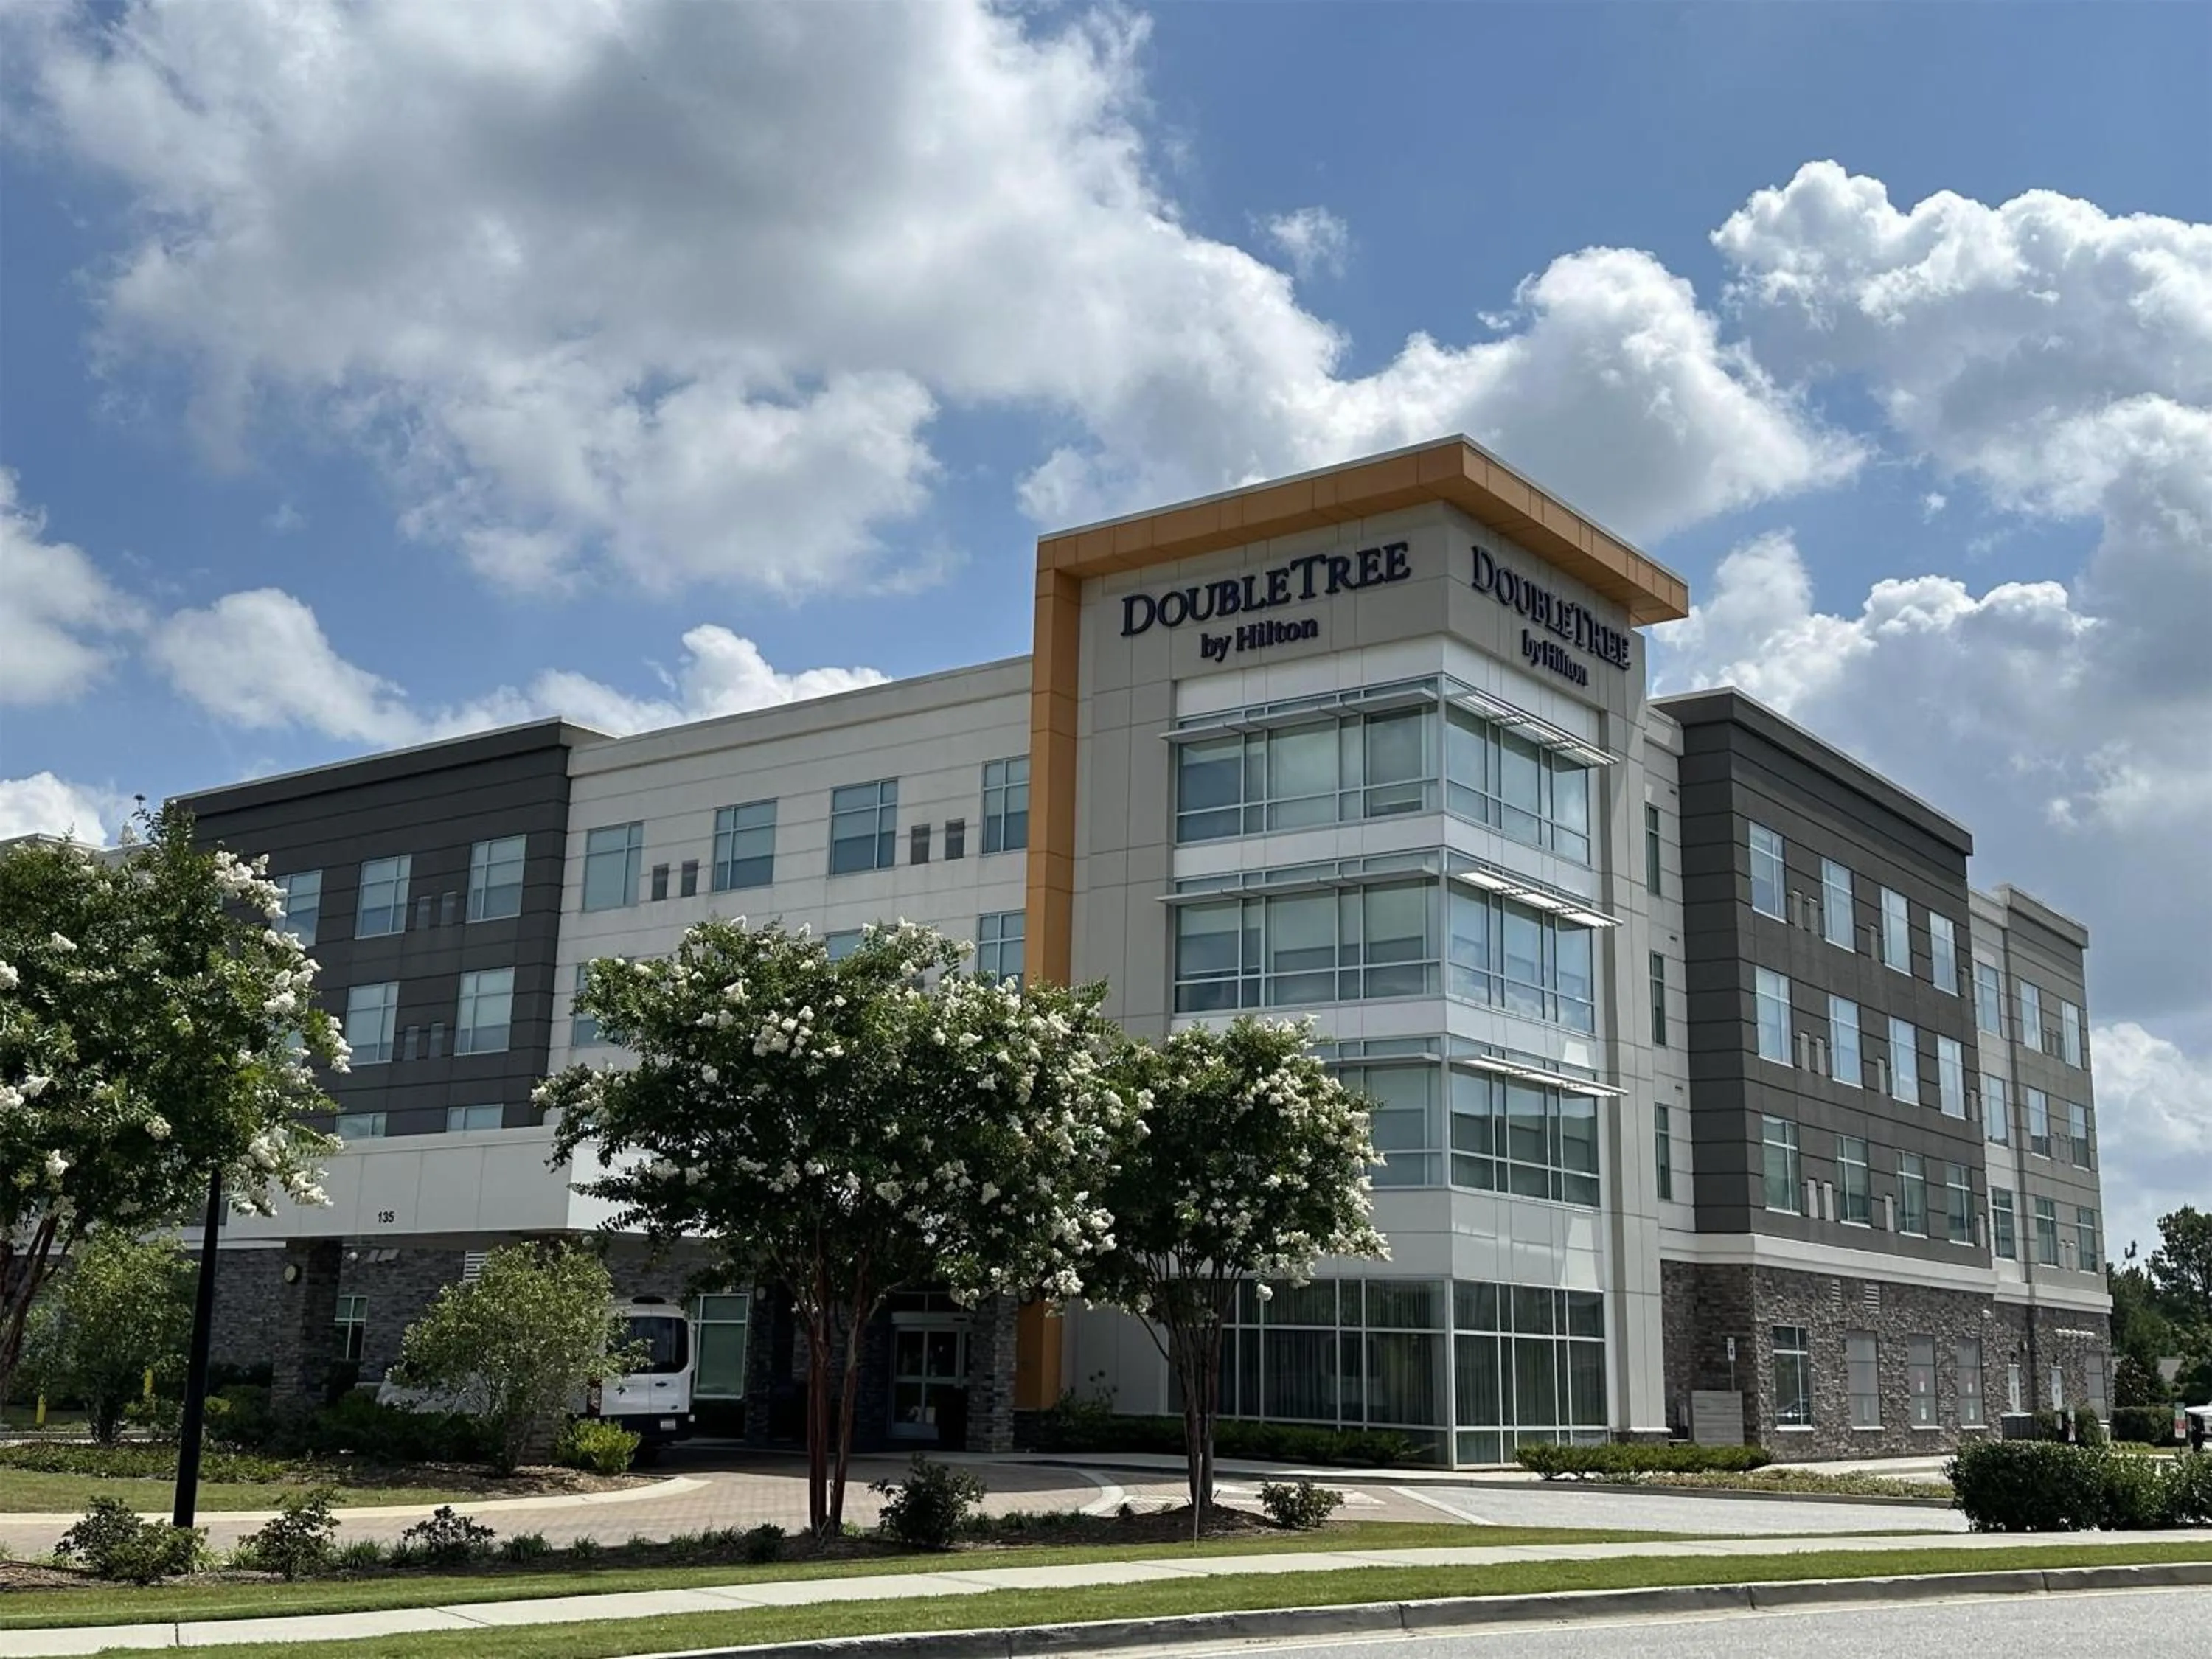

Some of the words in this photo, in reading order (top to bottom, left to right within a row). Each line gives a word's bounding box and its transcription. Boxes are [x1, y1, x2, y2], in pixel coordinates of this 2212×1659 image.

[1200, 633, 1232, 662] by
[1236, 617, 1318, 652] Hilton
[1521, 629, 1542, 667] by
[1541, 639, 1589, 686] Hilton
[378, 1211, 395, 1224] 135
